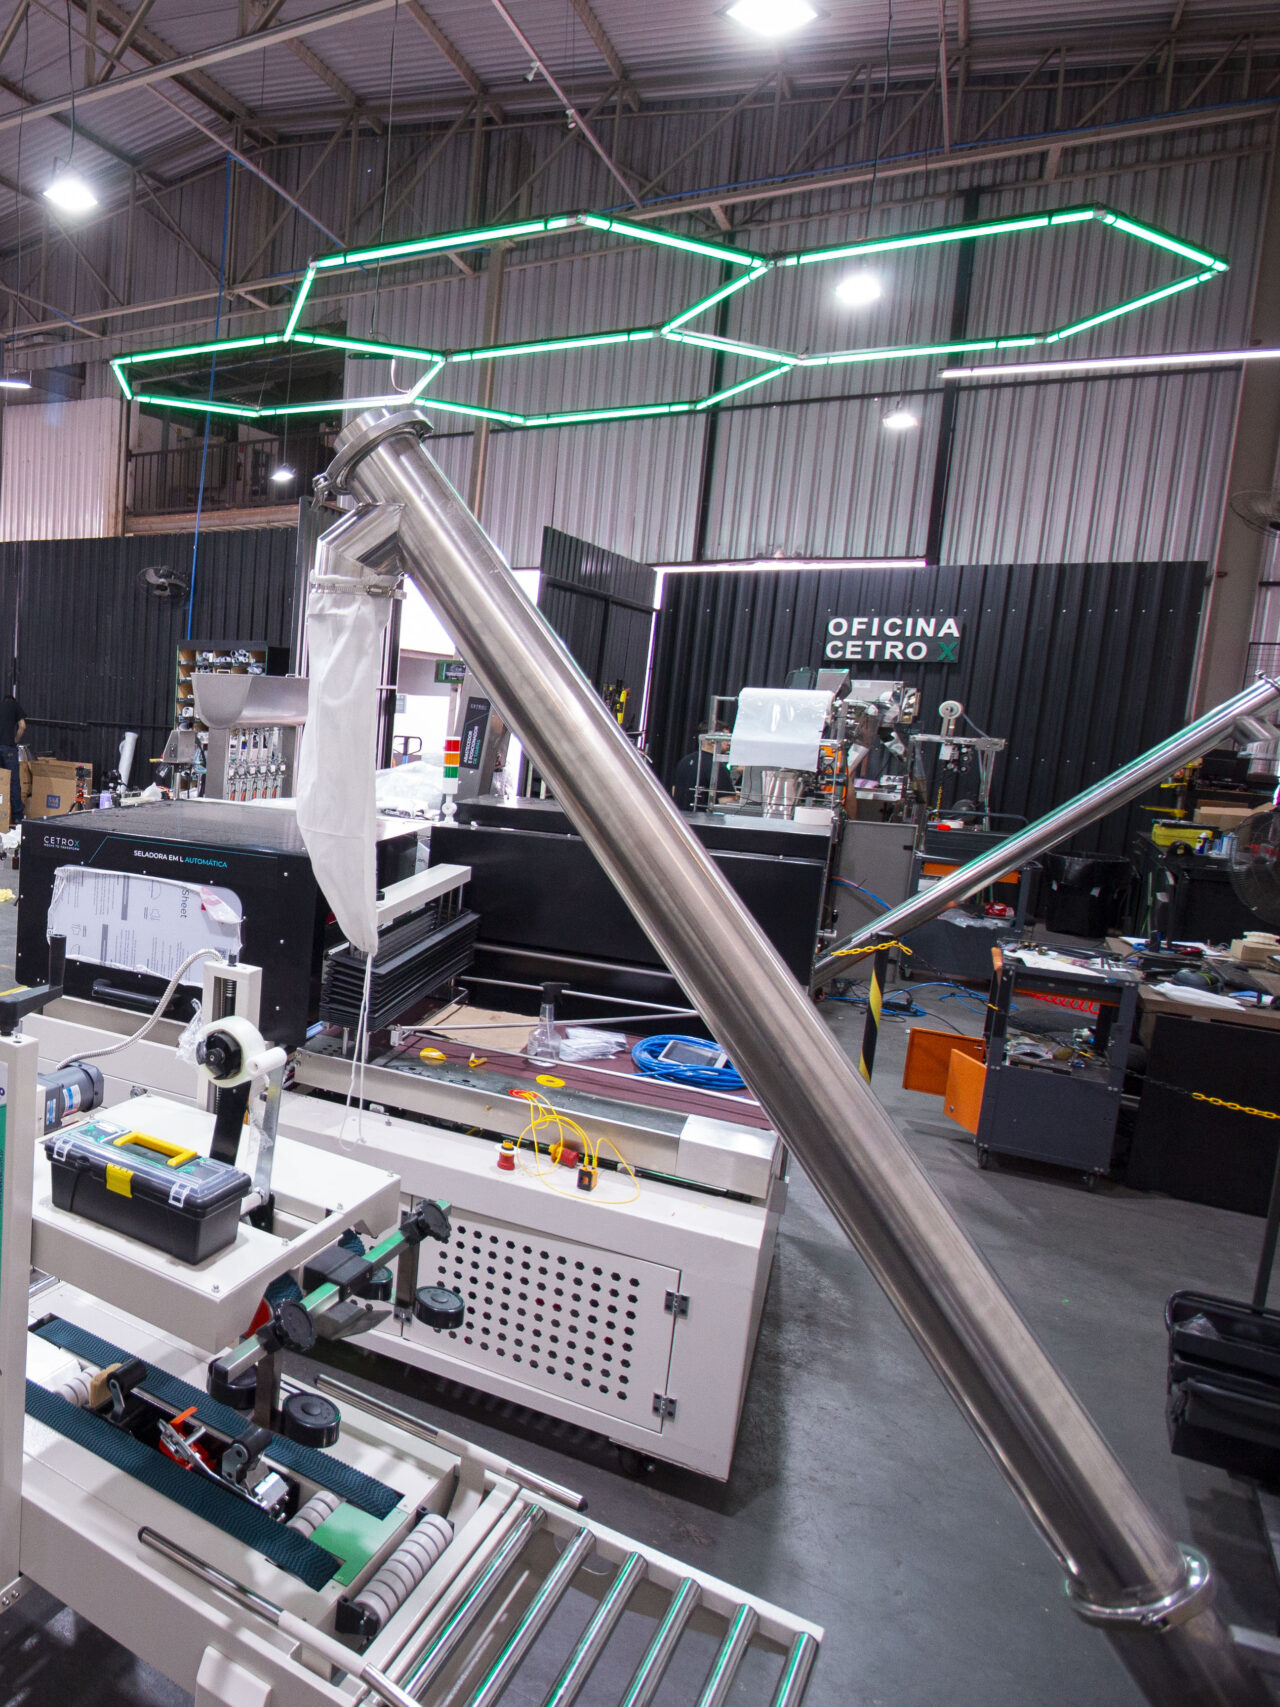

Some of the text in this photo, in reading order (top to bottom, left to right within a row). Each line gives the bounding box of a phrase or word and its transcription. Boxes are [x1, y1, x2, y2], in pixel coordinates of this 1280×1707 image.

[827, 617, 960, 637] OFICINA
[825, 640, 958, 660] CETRO X
[43, 835, 81, 847] CETROX
[133, 850, 168, 860] SELADORA
[168, 854, 179, 862] EM
[184, 857, 228, 868] AUTOMÁTICA
[180, 889, 190, 919] Sheet
